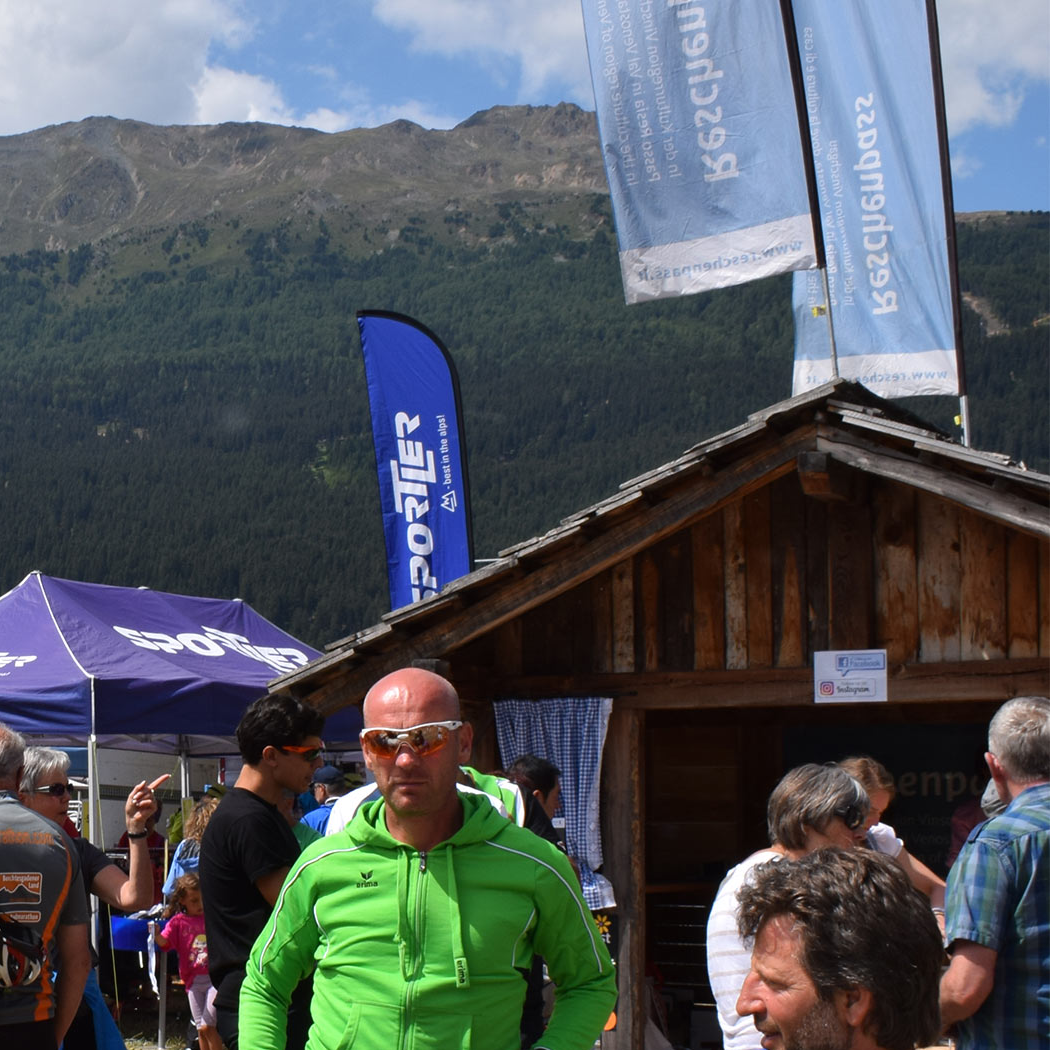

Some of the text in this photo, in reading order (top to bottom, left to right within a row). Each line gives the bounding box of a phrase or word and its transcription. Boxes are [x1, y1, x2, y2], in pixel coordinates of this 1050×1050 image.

[438, 437, 450, 454] the
[442, 465, 452, 485] best
[456, 960, 465, 984] erima
